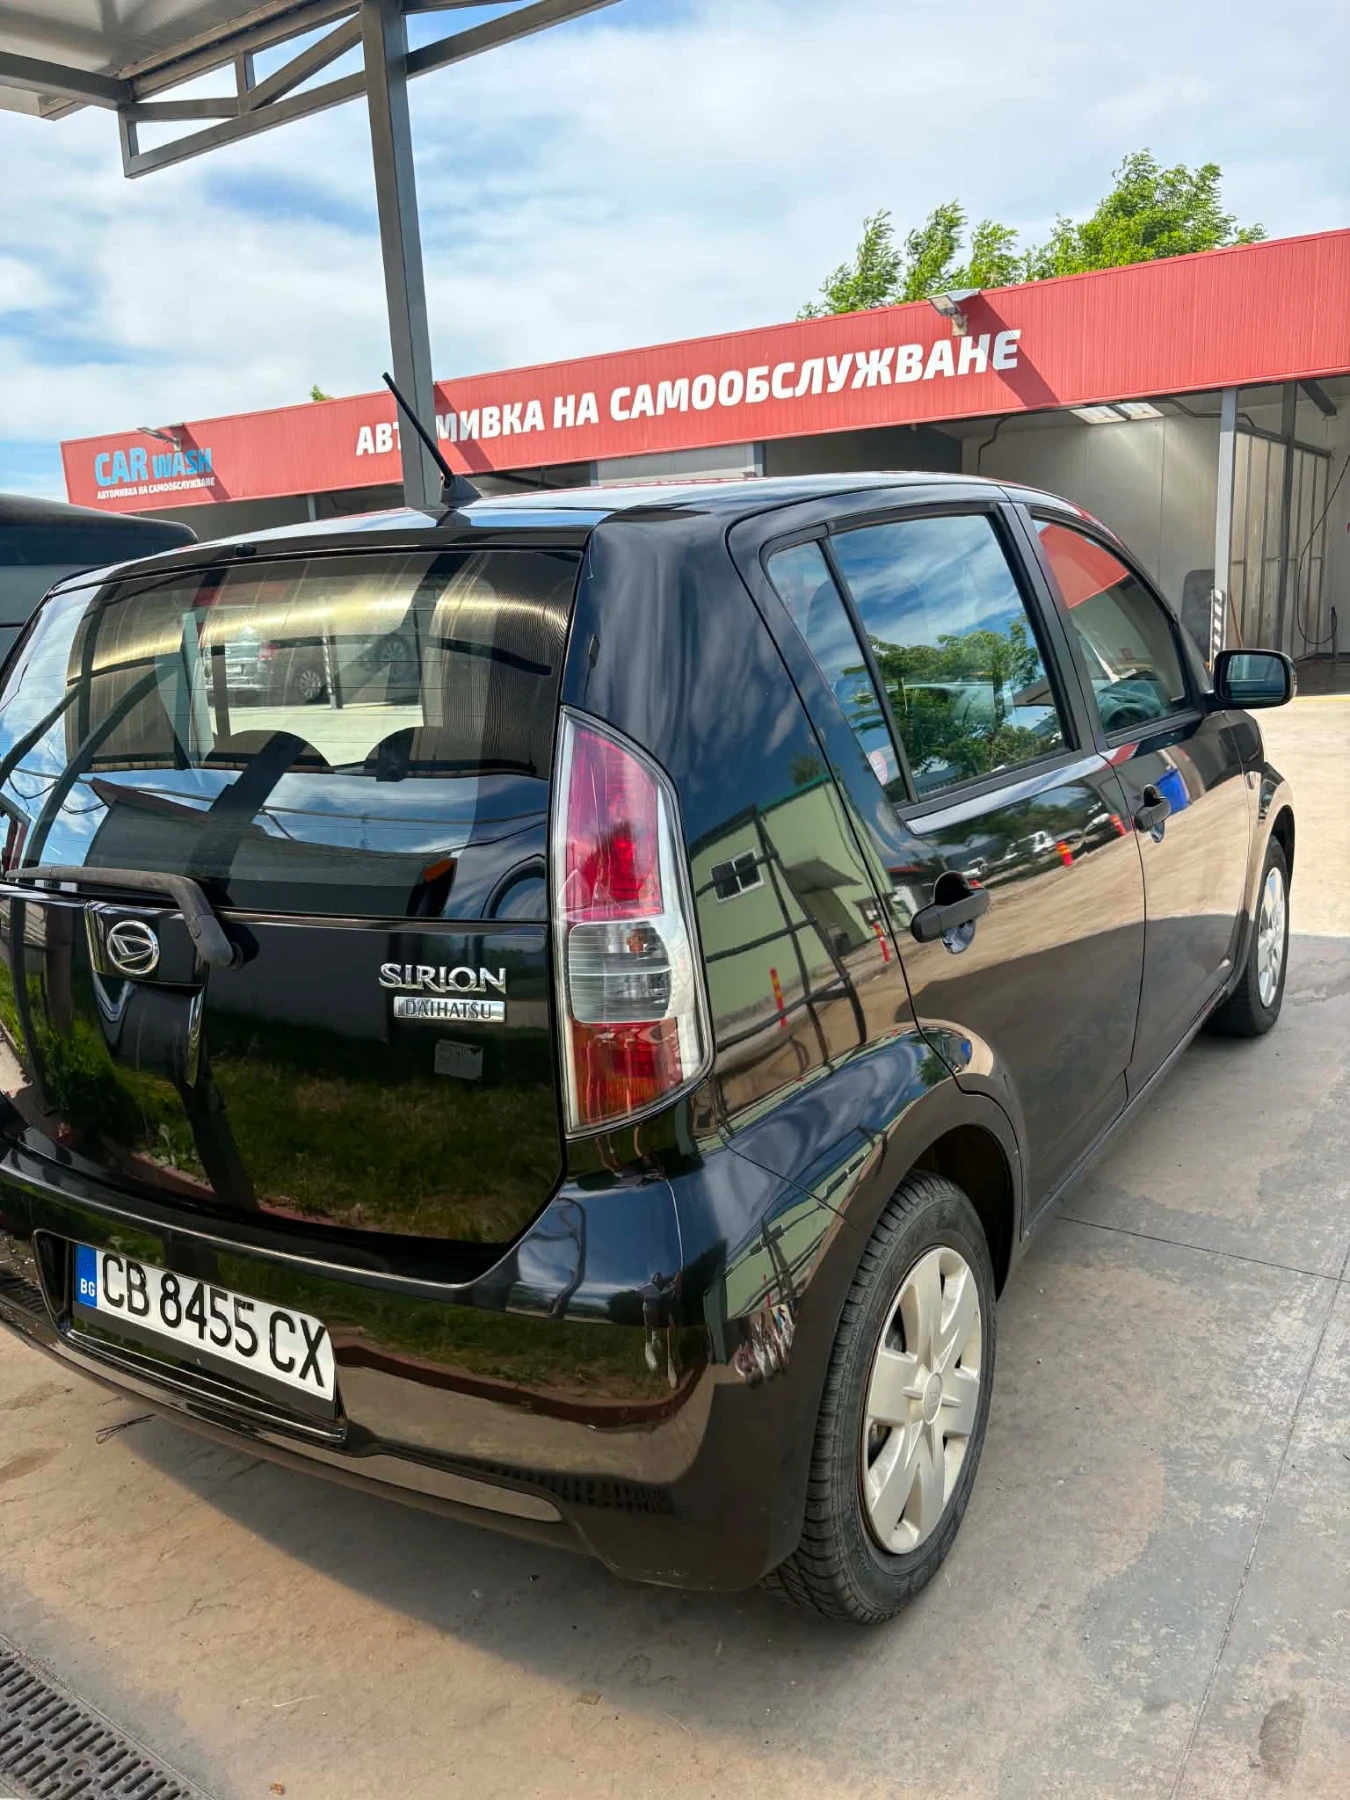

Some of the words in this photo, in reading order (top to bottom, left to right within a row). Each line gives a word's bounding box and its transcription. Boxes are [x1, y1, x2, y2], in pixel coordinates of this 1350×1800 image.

[356, 399, 545, 456] АВМИВКА
[553, 391, 599, 429] НА
[610, 329, 1022, 421] САМООБСЛУЖВАНЕ
[95, 447, 148, 486] CAR
[151, 448, 212, 478] WASH
[378, 963, 507, 995] SIRION
[404, 1000, 492, 1019] DAIHATSU
[80, 1278, 96, 1298] BG
[102, 1253, 150, 1317] CB
[159, 1273, 258, 1358] 8455
[269, 1310, 326, 1388] CX
